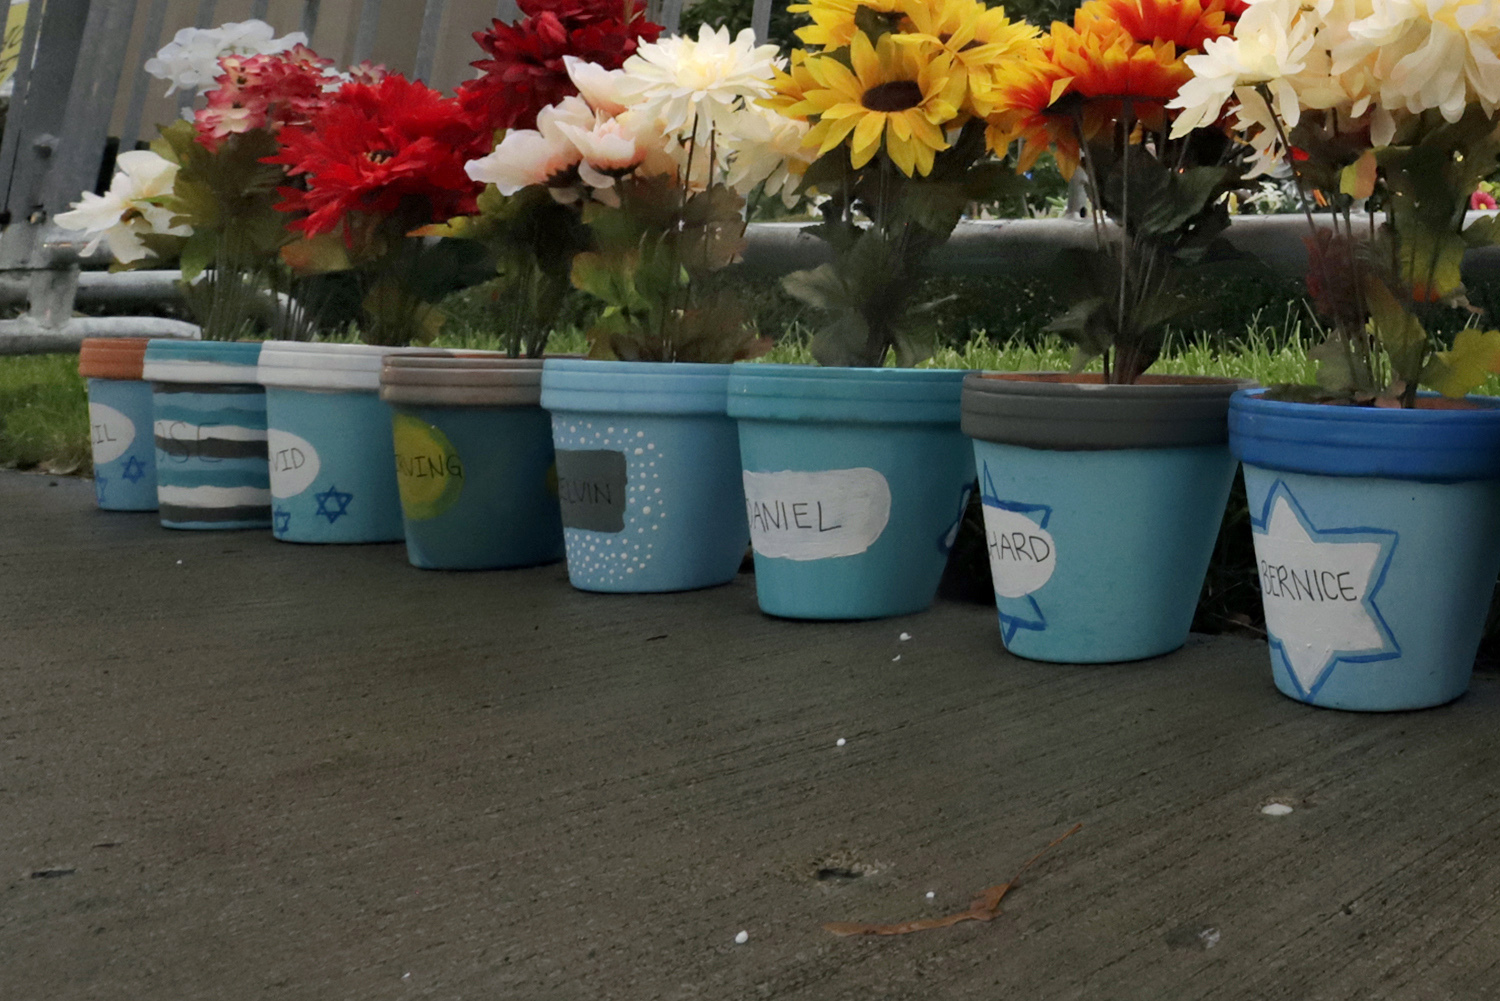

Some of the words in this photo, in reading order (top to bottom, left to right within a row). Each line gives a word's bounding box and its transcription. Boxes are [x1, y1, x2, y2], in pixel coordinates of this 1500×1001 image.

[92, 423, 118, 445] IL
[156, 421, 223, 463] OSE
[269, 447, 306, 472] VID
[990, 531, 1051, 563] HARD
[1260, 559, 1358, 602] BERNICE
